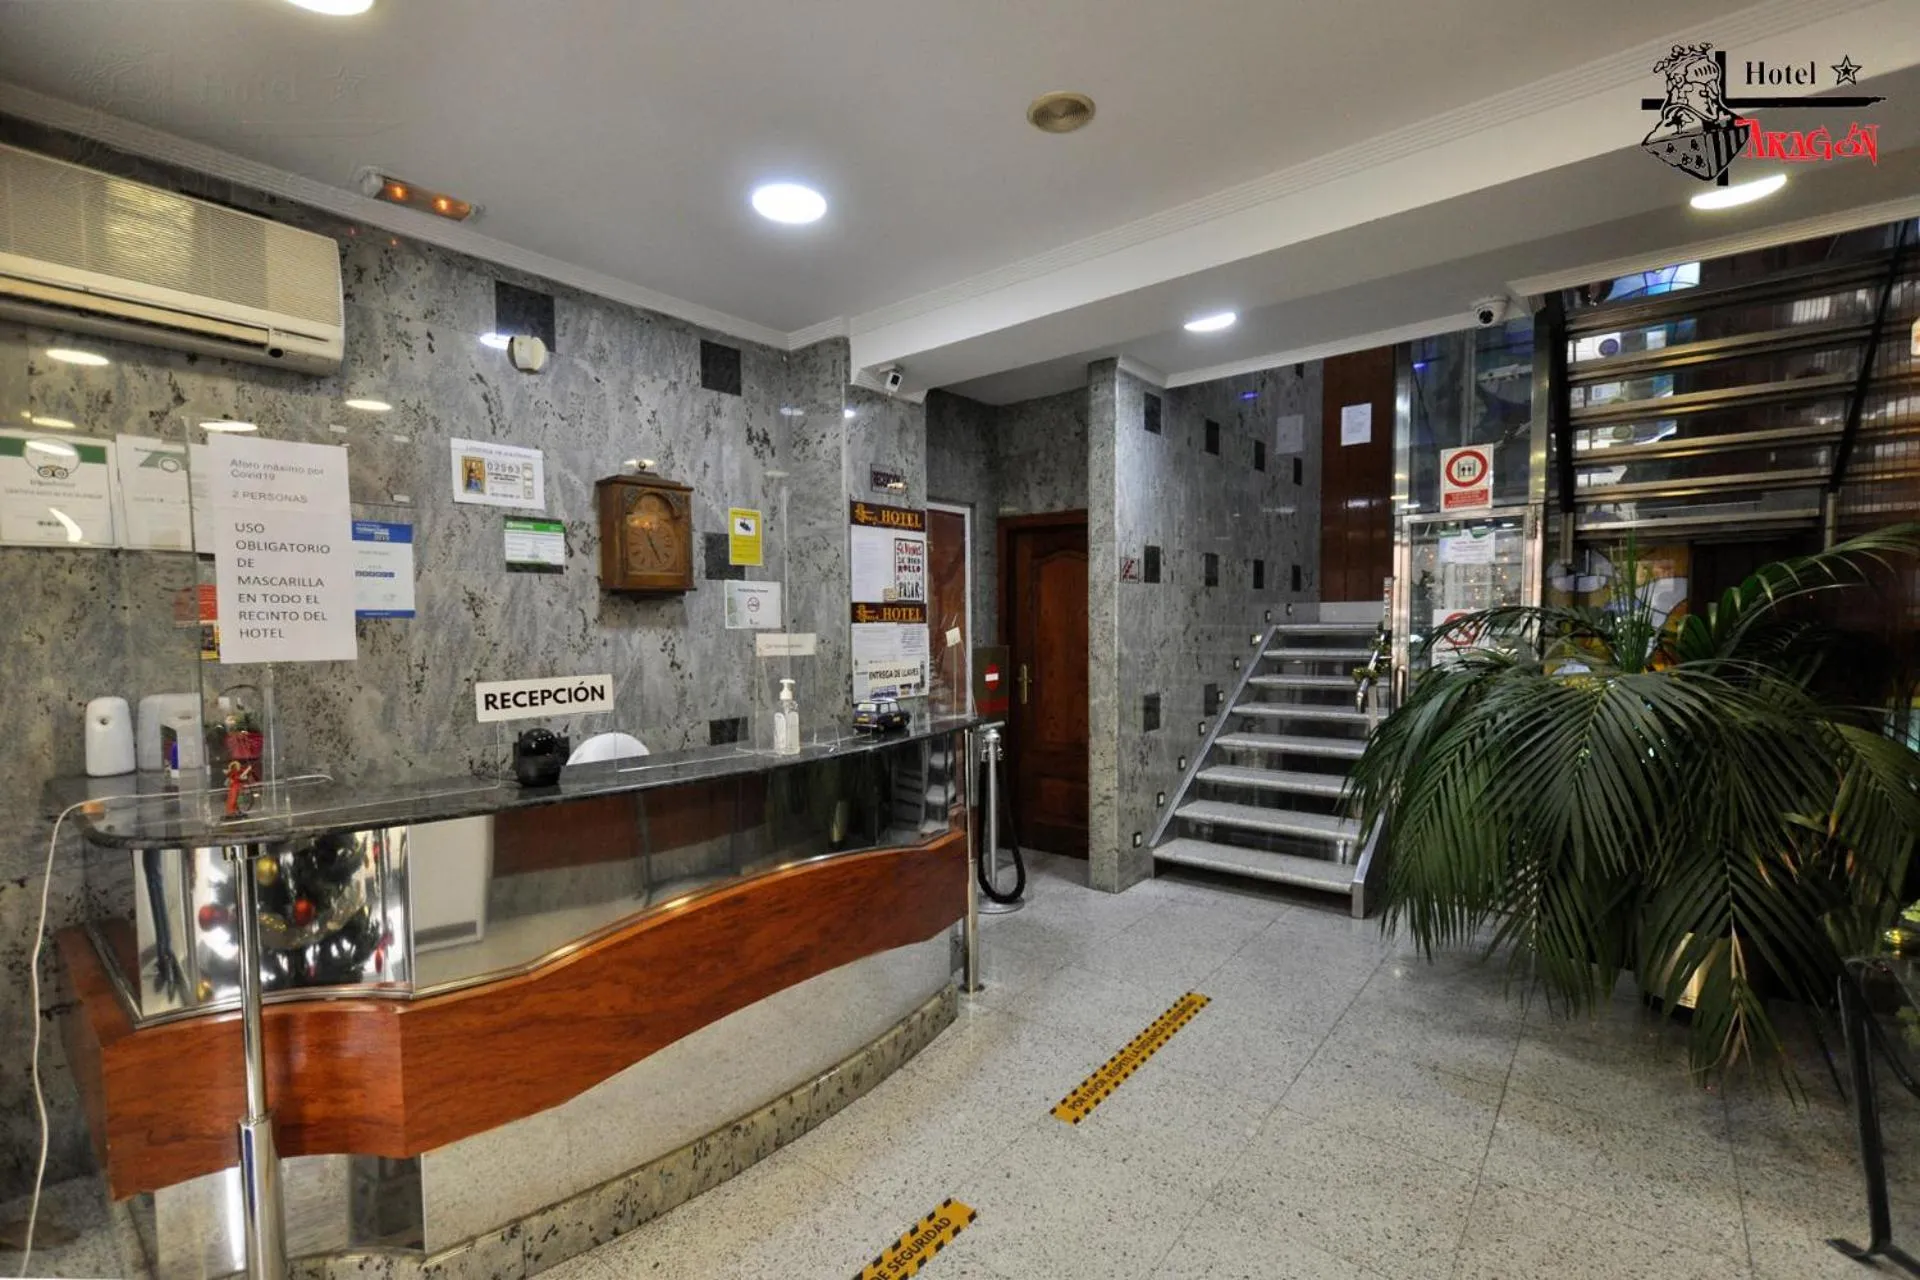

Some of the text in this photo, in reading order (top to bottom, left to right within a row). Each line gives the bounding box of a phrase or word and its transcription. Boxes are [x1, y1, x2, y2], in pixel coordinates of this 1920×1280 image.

[242, 491, 308, 504] PERSONAS
[881, 509, 922, 529] HOTEL
[234, 522, 265, 534] USO
[235, 539, 331, 555] OBLIGATORIO
[237, 558, 255, 569] DE
[237, 575, 325, 588] MASCARILLA
[237, 593, 320, 605] EN TODO EL
[238, 611, 328, 622] RECINTO DEL
[882, 607, 923, 621] HOTEL
[240, 628, 285, 639] HOTEL
[484, 681, 605, 711] RECEPCIÓN
[887, 1217, 952, 1274] SEGURIDAD
